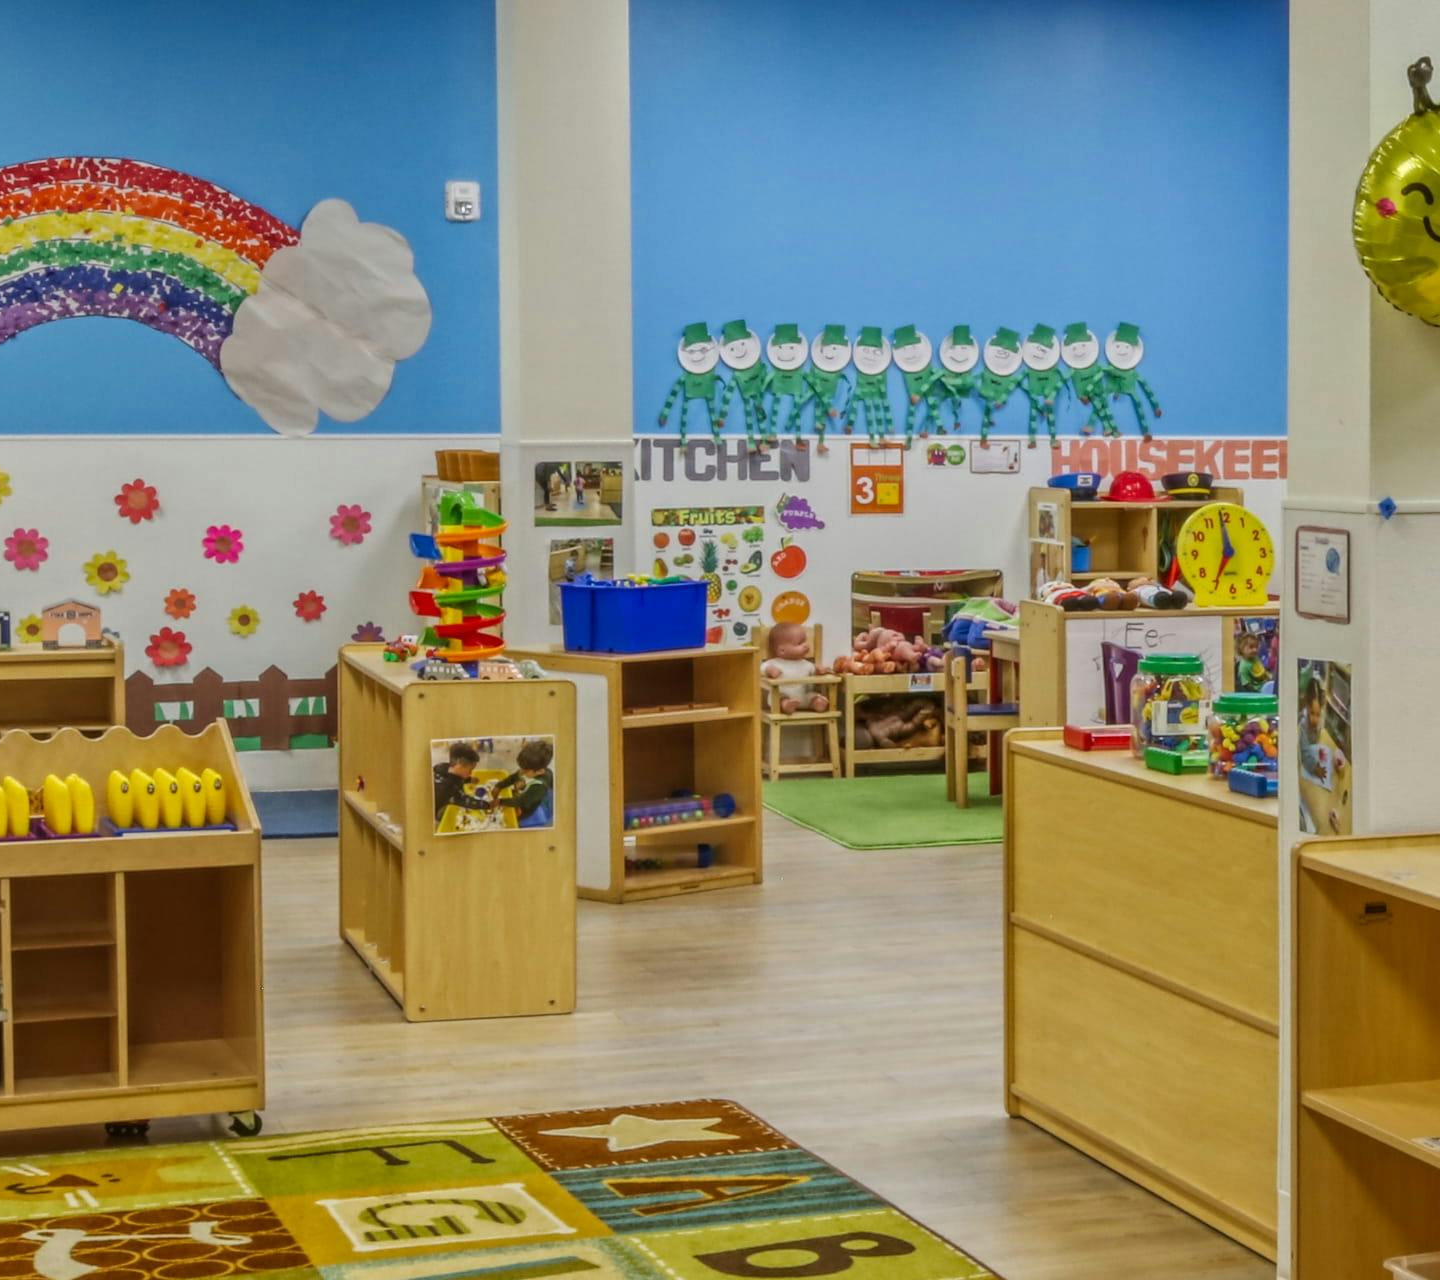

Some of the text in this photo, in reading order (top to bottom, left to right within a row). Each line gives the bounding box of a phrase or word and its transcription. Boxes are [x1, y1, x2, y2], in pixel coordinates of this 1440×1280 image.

[633, 438, 811, 483] ITCHEN
[854, 475, 876, 506] 3
[678, 509, 738, 527] Fruits
[783, 509, 815, 520] PURPLE
[1203, 517, 1215, 530] 11
[1238, 516, 1246, 528] 1
[1191, 530, 1206, 543] 10
[1251, 528, 1261, 541] 2
[1191, 548, 1200, 561] 9
[1258, 546, 1268, 559] 3
[772, 552, 788, 568] RED
[1198, 567, 1207, 579] 8
[1255, 564, 1264, 577] 4
[1212, 579, 1221, 592] 7
[1228, 583, 1237, 595] 6
[1245, 578, 1254, 590] 5
[774, 598, 807, 614] ORANGE
[1124, 621, 1161, 650] Ee
[602, 1173, 814, 1219] A
[357, 1191, 527, 1243] G
[693, 1231, 918, 1279] B
